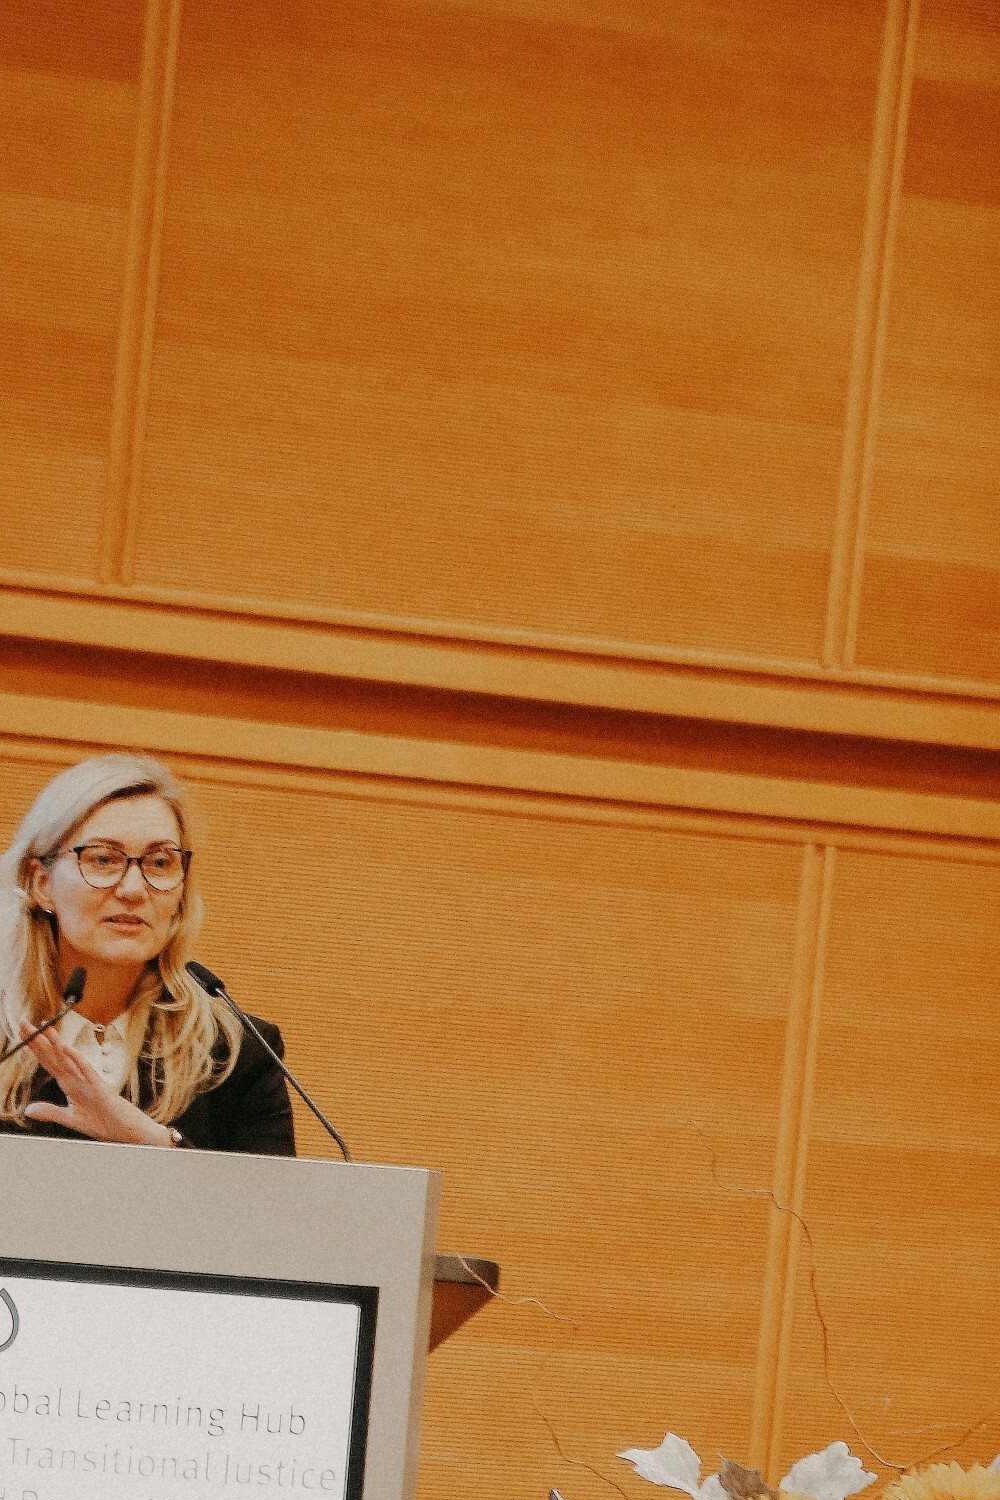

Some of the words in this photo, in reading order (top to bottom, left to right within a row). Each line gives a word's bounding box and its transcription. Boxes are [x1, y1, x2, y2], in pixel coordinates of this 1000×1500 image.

[76, 1389, 227, 1437] Learning
[240, 1402, 307, 1436] Hub
[6, 1437, 211, 1482] Transitional
[221, 1454, 337, 1492] Justice
